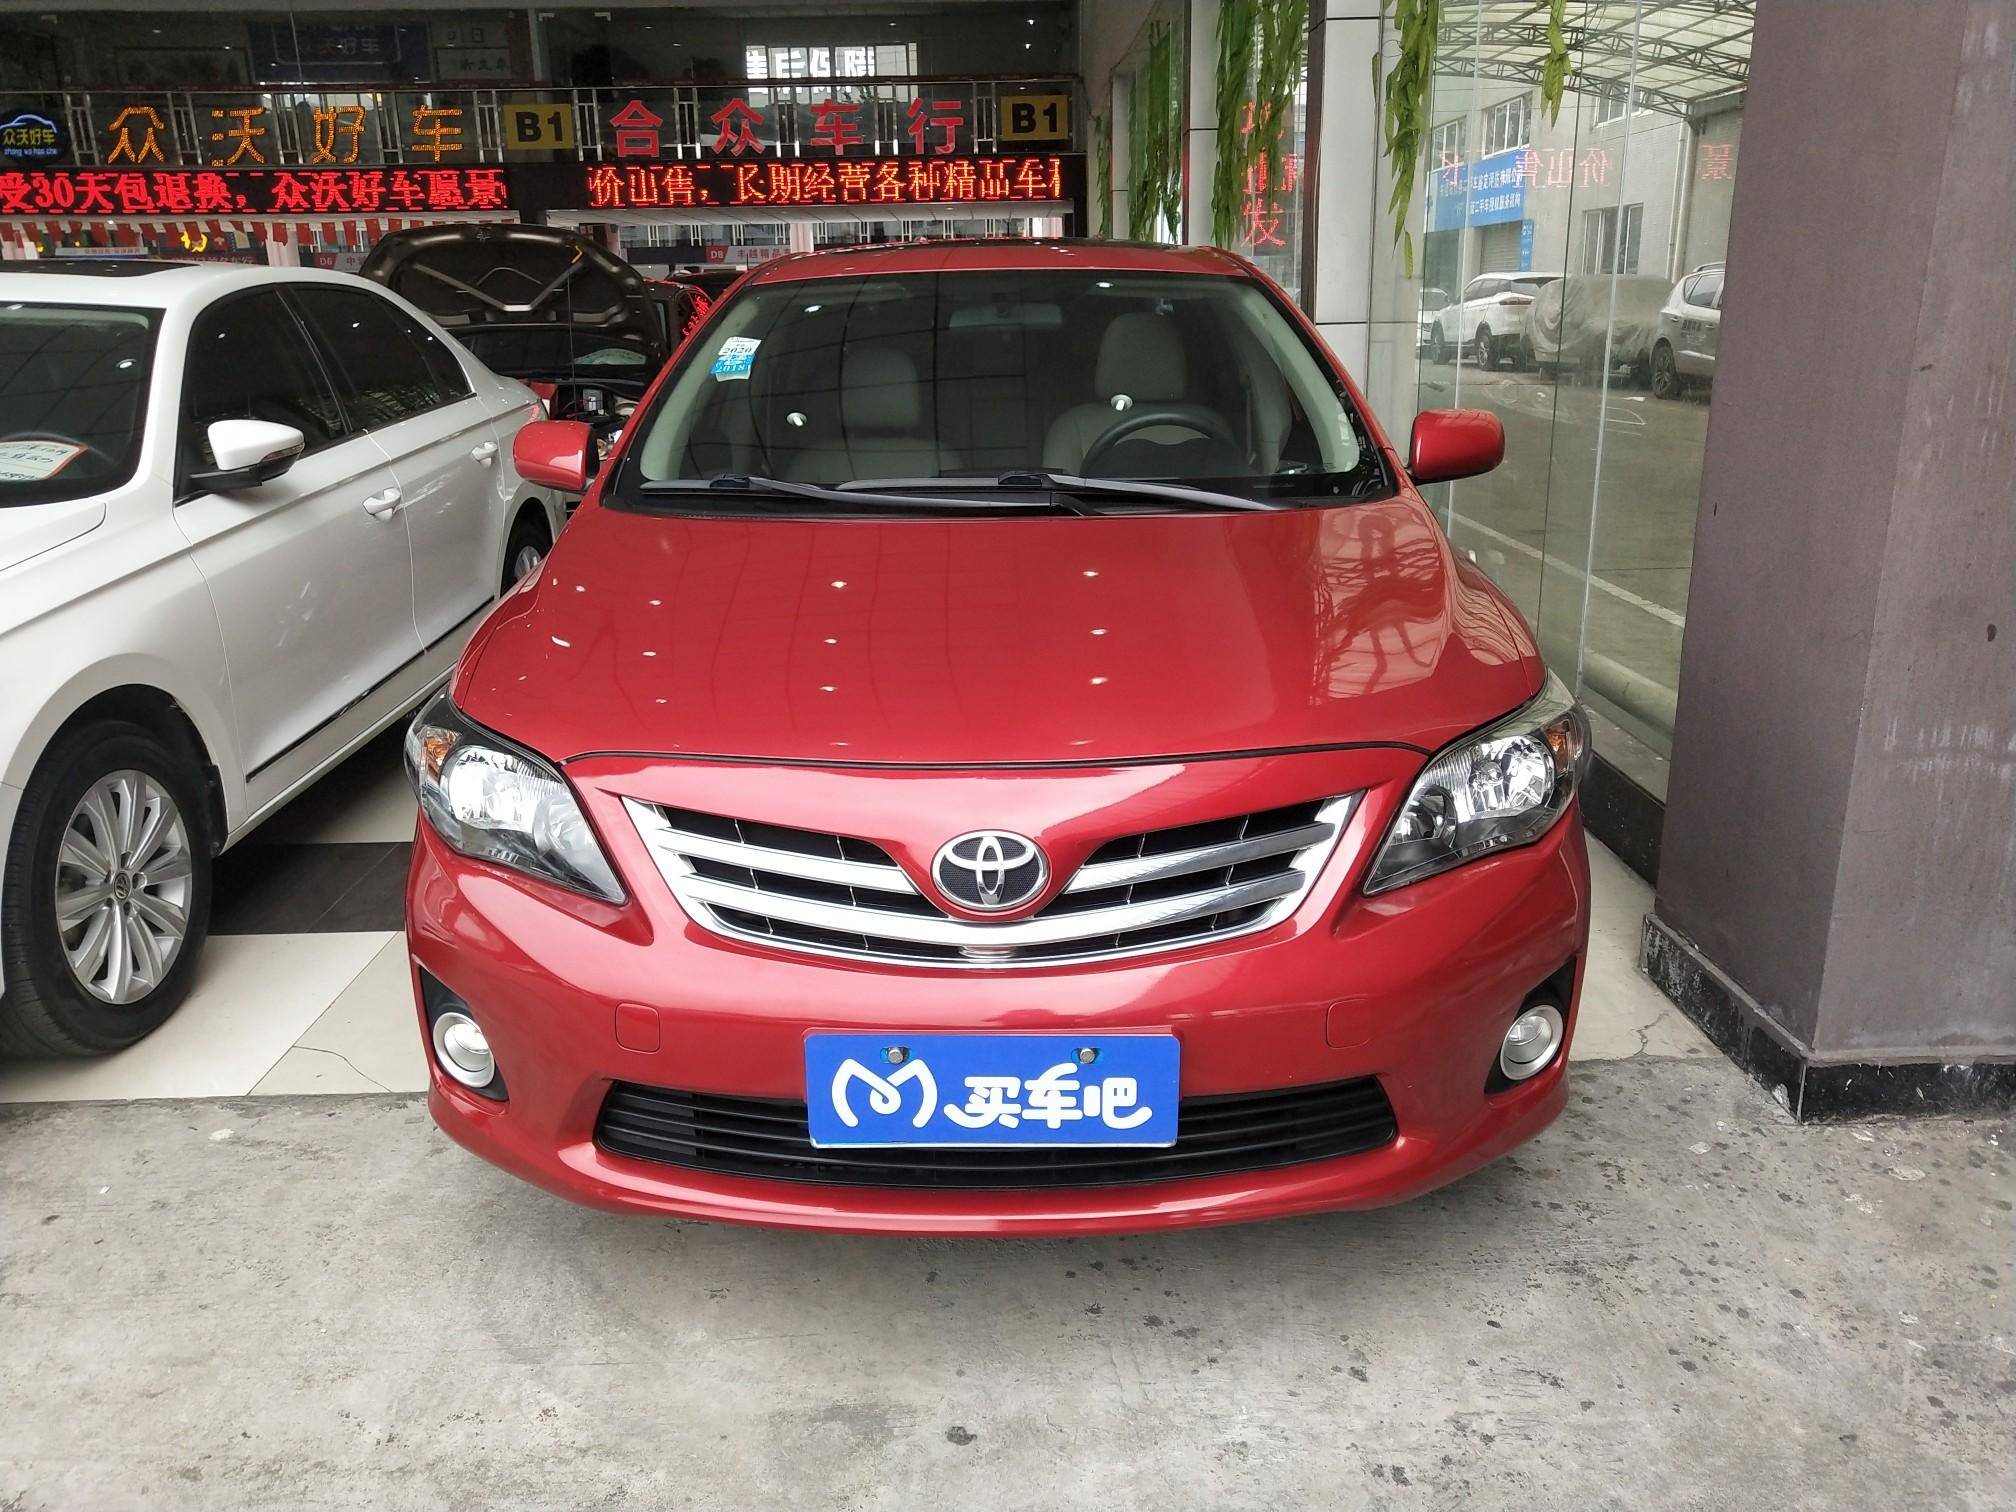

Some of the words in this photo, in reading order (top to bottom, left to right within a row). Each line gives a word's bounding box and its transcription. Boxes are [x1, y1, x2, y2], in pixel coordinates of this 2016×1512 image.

[3, 128, 55, 146] 众沃好车
[108, 104, 464, 166] 众沃好车
[515, 111, 563, 142] B1
[610, 98, 964, 157] 合众车行
[1012, 102, 1058, 134] B1
[943, 1062, 1153, 1130] 买车吧
